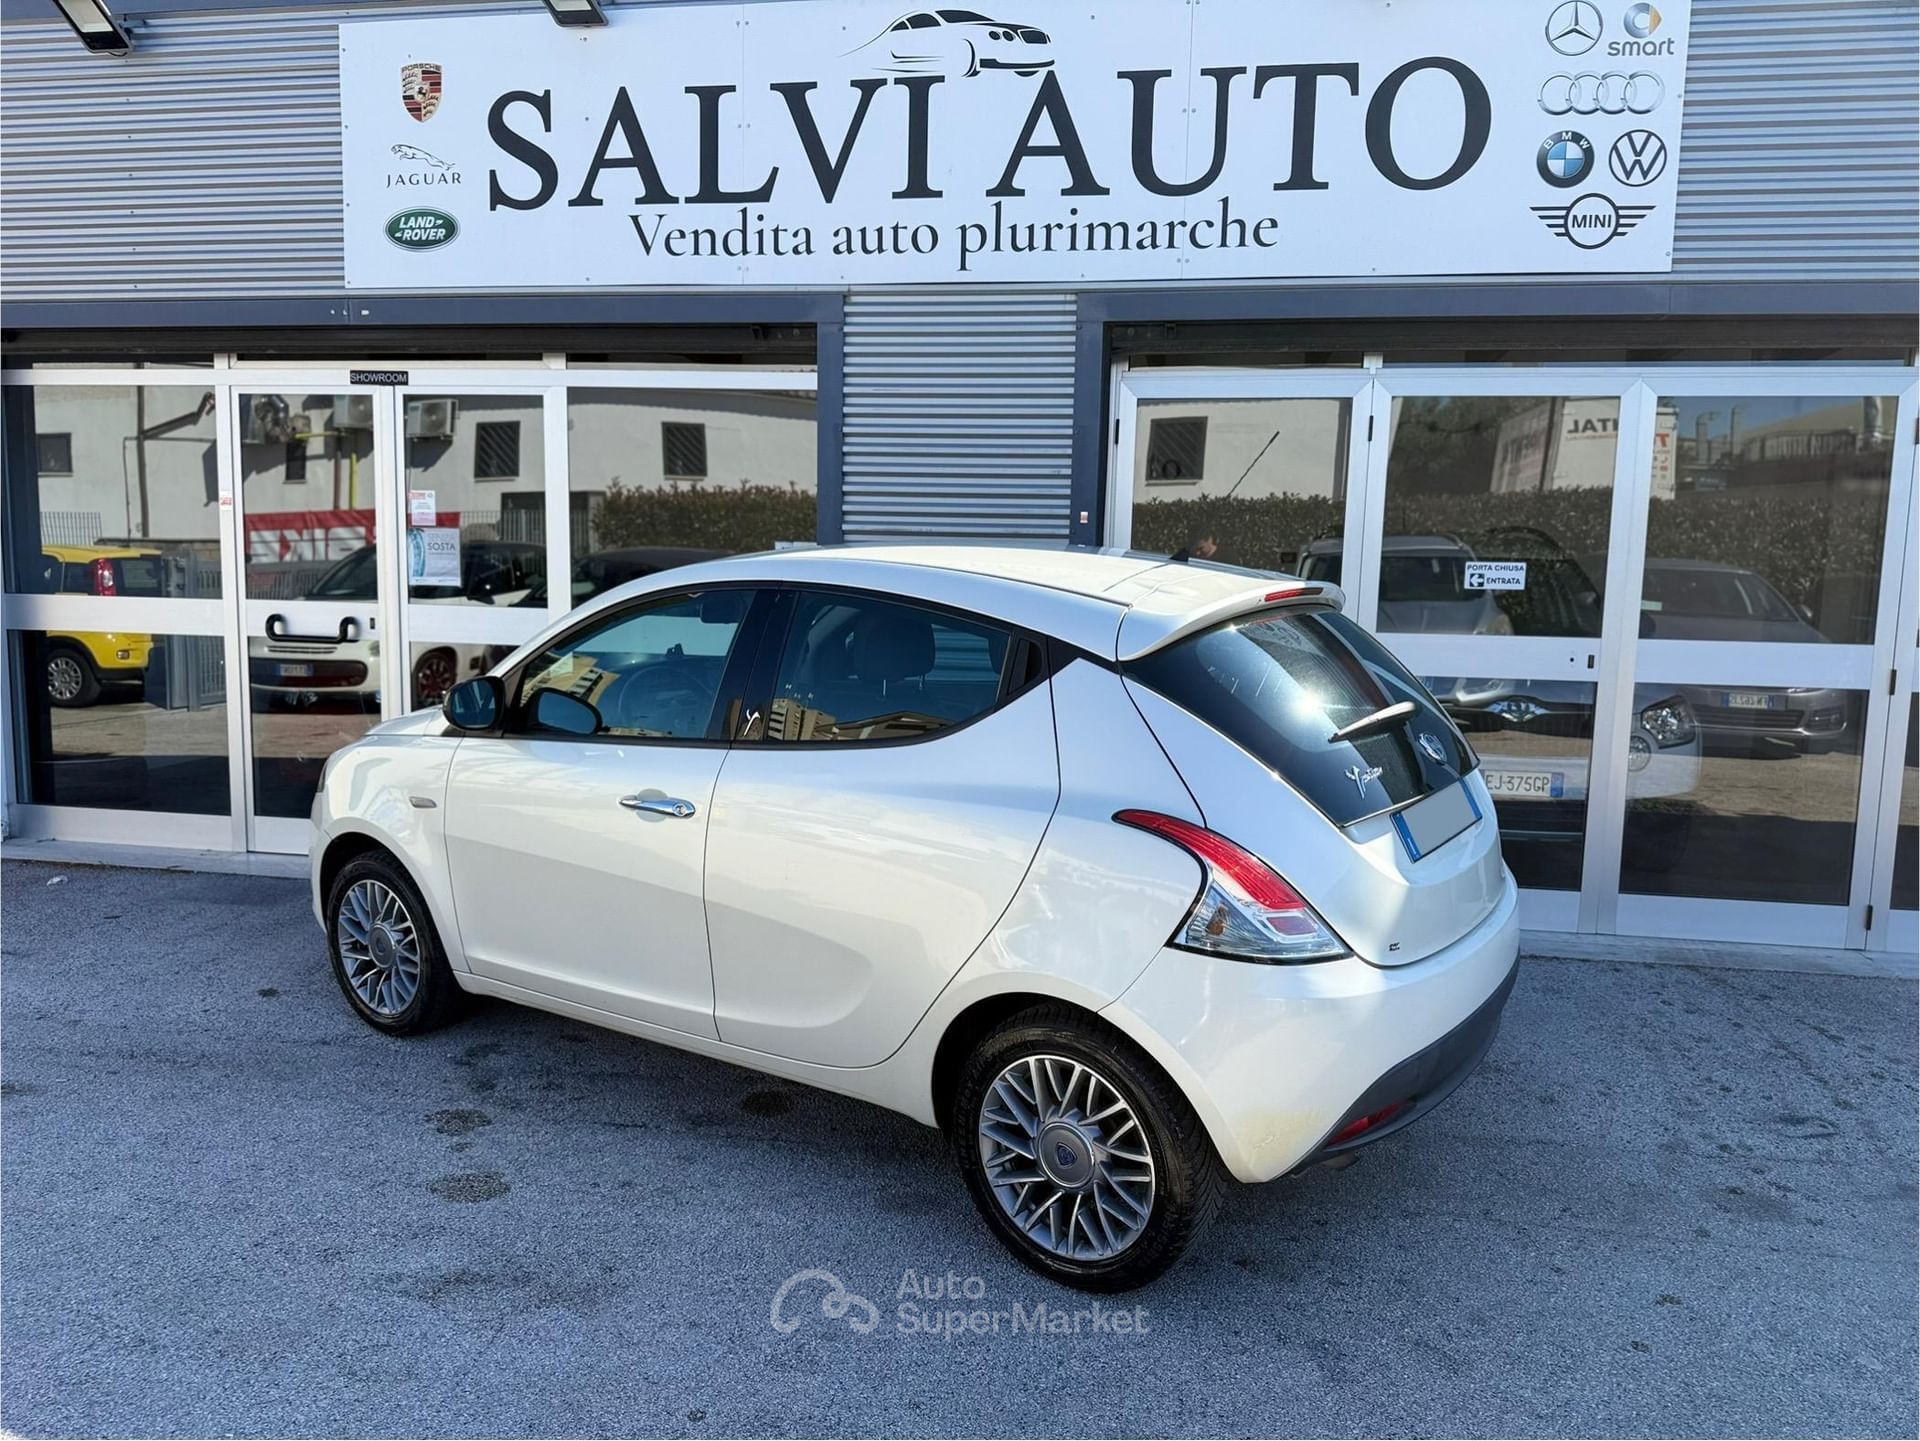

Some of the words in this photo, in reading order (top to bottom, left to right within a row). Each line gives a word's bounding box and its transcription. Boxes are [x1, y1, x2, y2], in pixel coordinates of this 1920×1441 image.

[1607, 37, 1675, 57] smart
[487, 75, 945, 212] SALVI
[986, 57, 1492, 198] AUTO
[1543, 131, 1591, 150] BMW
[386, 172, 462, 188] JAGUAR
[399, 215, 435, 229] LAND
[1571, 214, 1612, 228] MINI
[402, 228, 447, 241] ROVER
[628, 206, 815, 257] Vendita
[832, 221, 939, 255] auto
[957, 195, 1278, 272] plurimarche
[350, 372, 407, 383] SHOWROOM
[427, 542, 456, 551] SOSTA
[1486, 577, 1521, 585] ENTRATA
